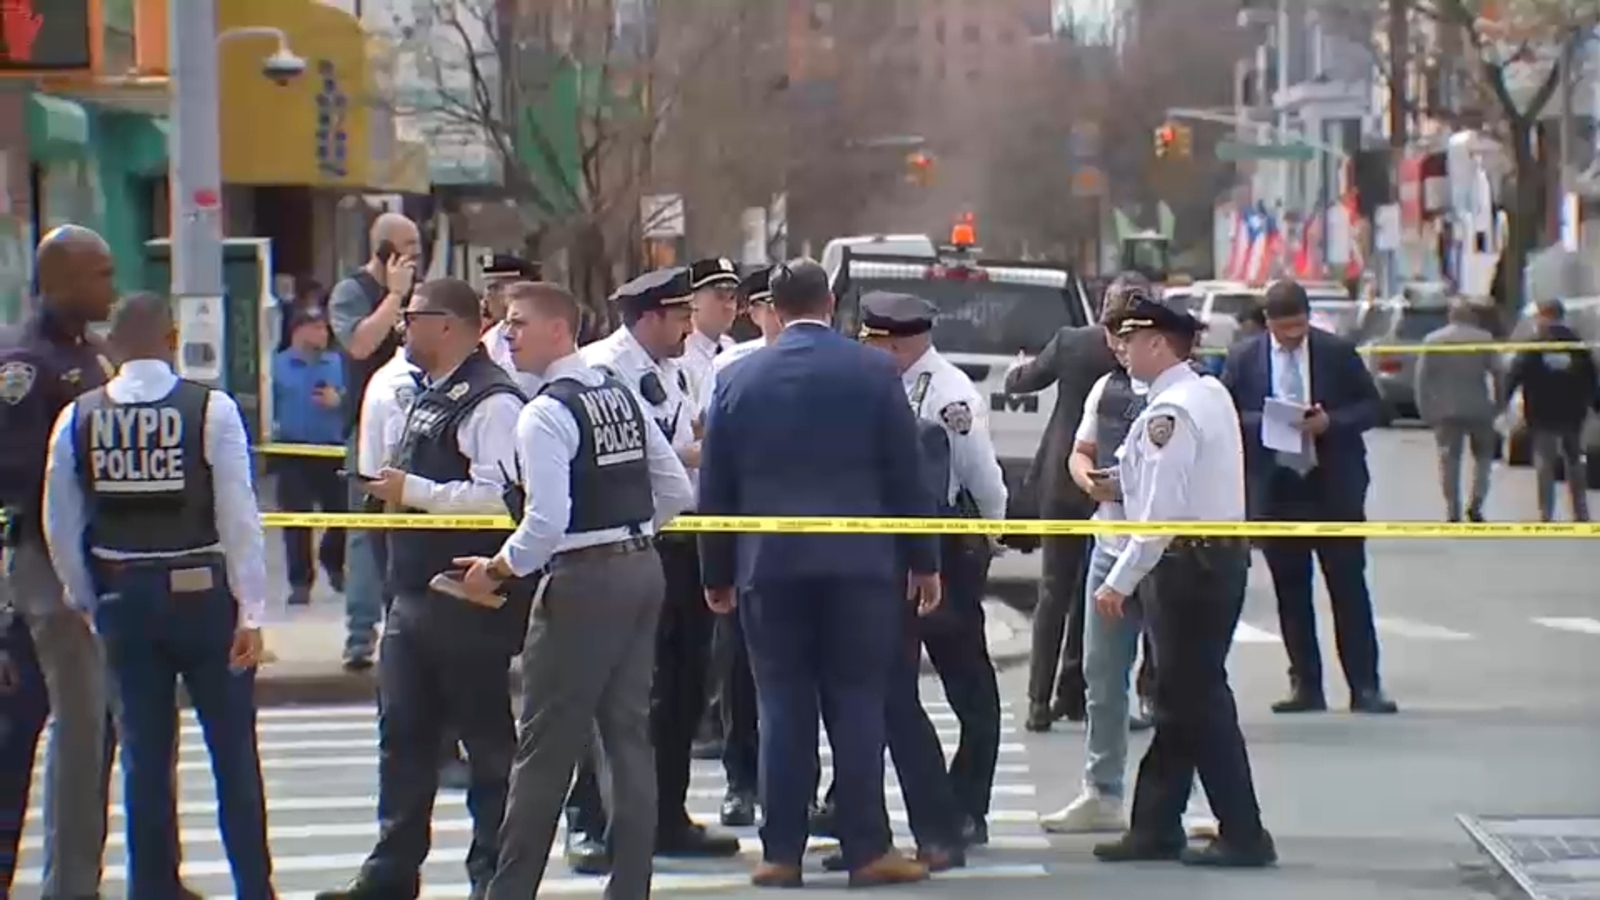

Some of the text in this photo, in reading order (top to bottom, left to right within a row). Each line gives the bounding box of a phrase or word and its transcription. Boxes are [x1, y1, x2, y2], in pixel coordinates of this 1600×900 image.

[578, 388, 633, 426] NYPD
[91, 407, 182, 448] NYPD
[594, 421, 642, 453] POLICE
[91, 449, 184, 479] POLICE
